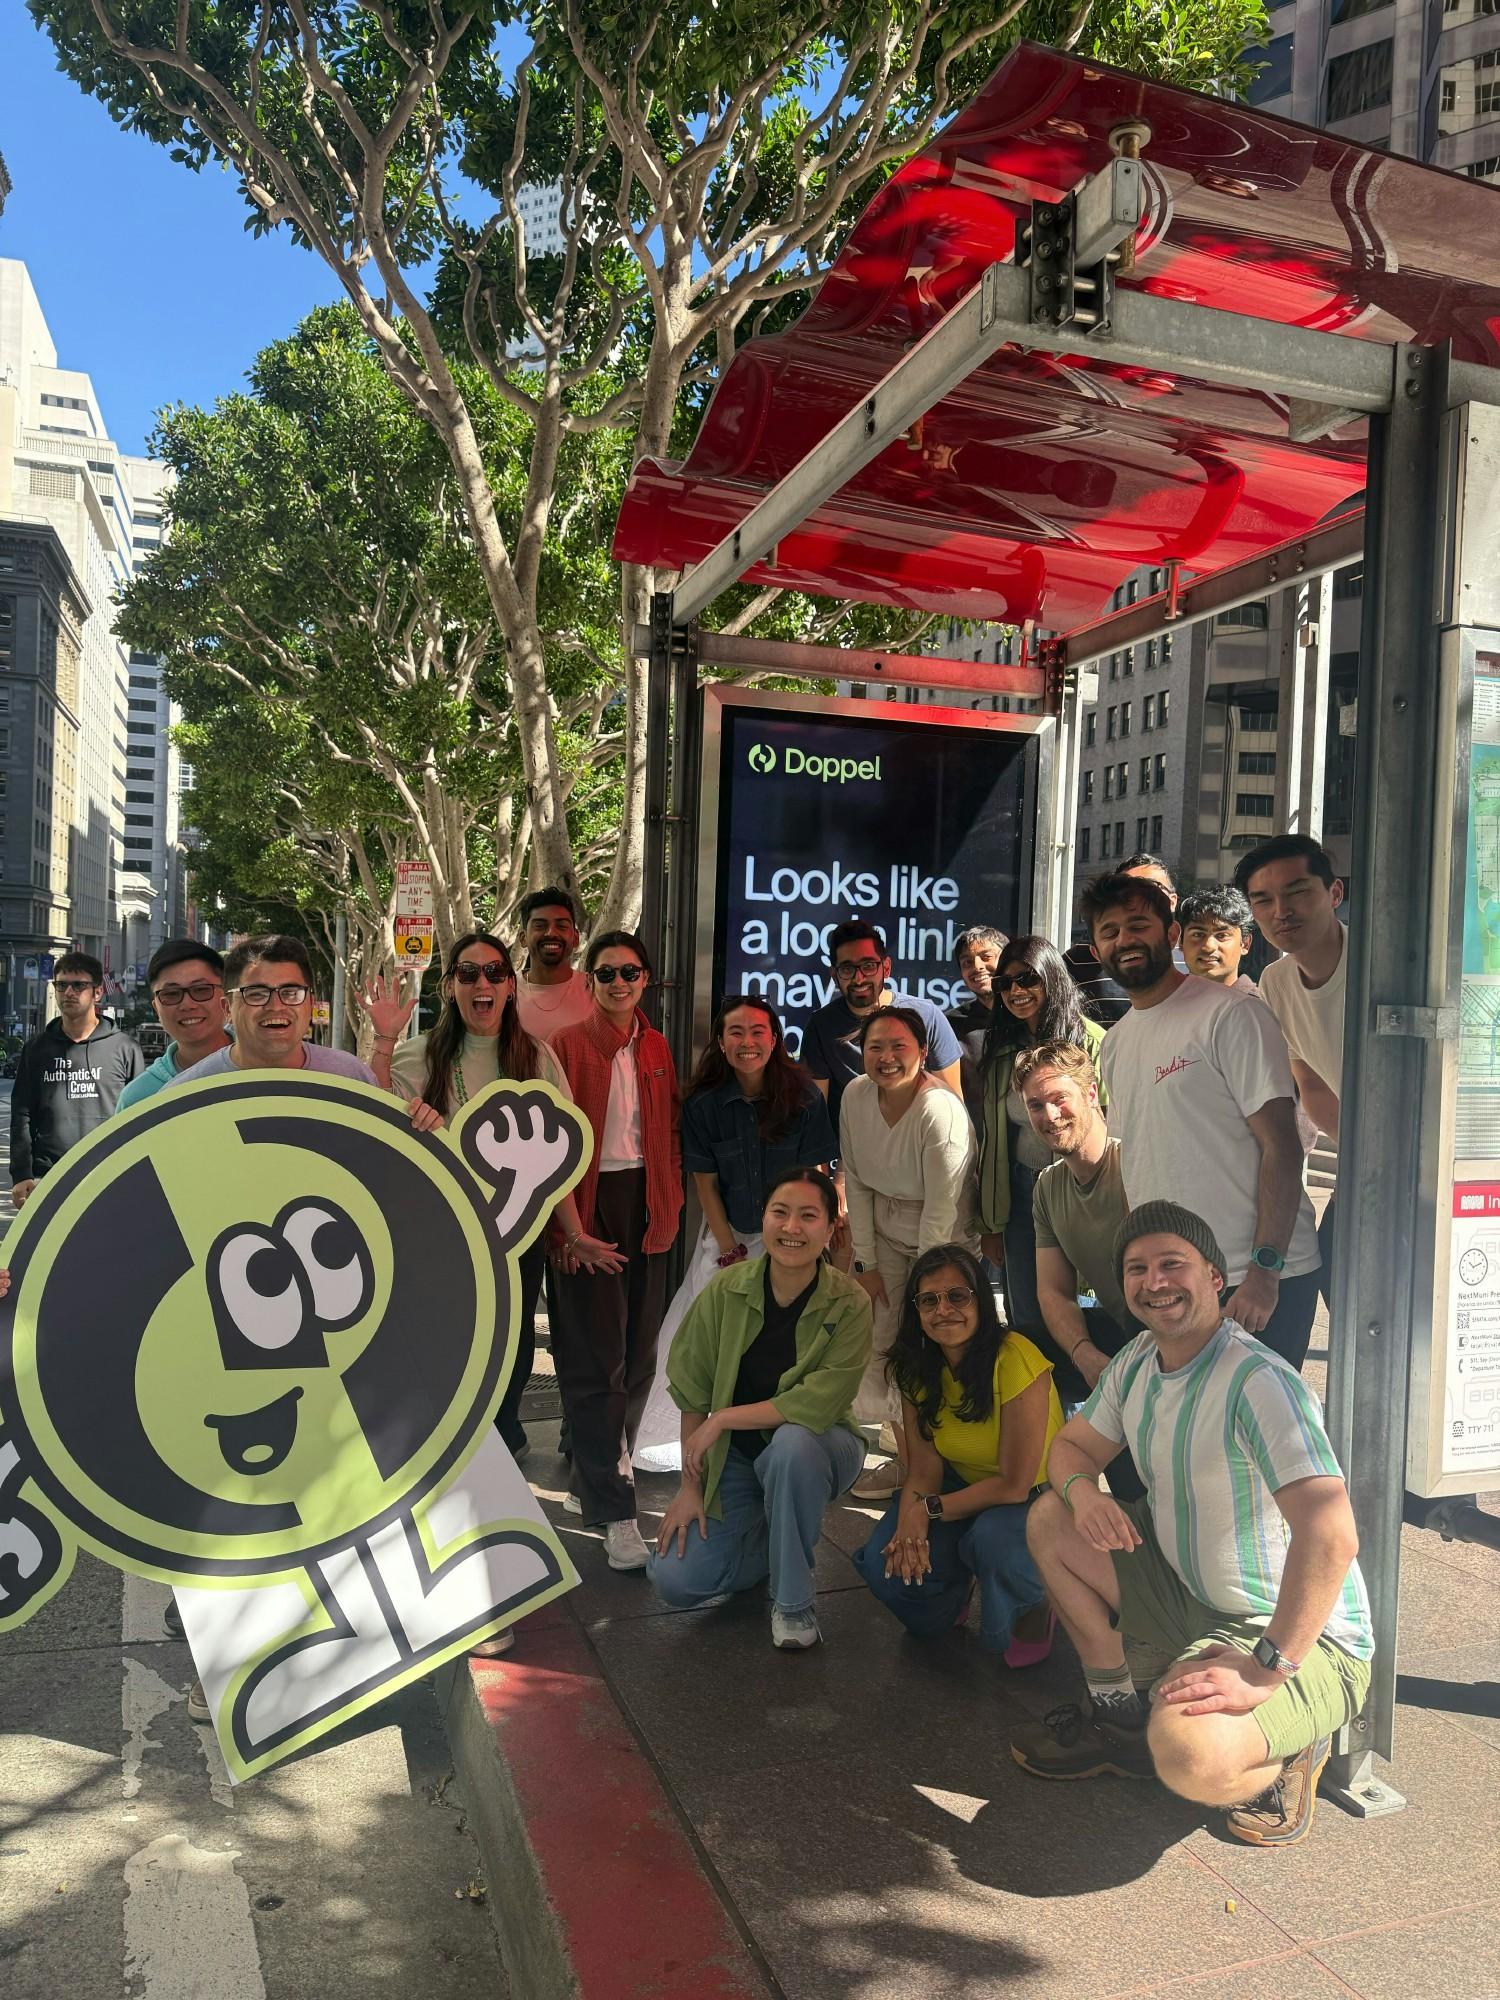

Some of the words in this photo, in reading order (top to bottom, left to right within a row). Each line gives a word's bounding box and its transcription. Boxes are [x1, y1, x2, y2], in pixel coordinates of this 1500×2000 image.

[785, 747, 882, 784] Doppel
[745, 855, 880, 907] Looks
[890, 864, 960, 912] like
[408, 886, 422, 896] ANY
[407, 897, 424, 907] TIME
[741, 919, 769, 955] a
[54, 1057, 72, 1069] The
[70, 1080, 96, 1093] Crew
[1468, 1425, 1482, 1434] TTY
